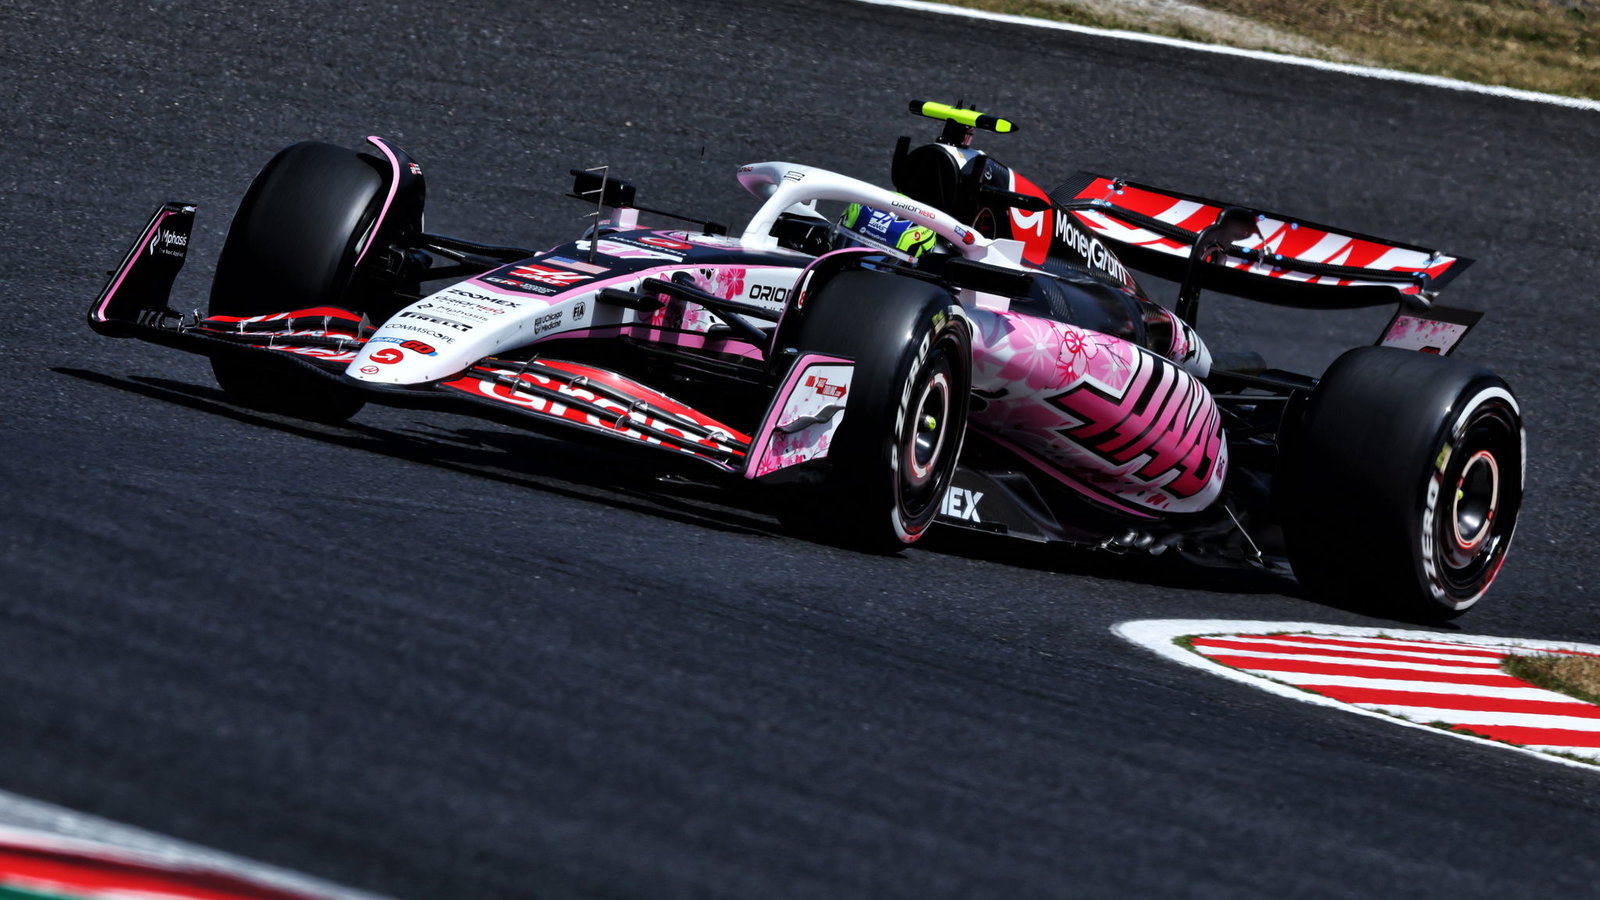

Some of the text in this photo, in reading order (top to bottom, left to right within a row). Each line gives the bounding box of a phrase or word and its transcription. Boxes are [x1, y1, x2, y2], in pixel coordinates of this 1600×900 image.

[161, 229, 187, 247] Mphasis
[1055, 209, 1128, 286] MoneyGram
[447, 288, 521, 308] ZOOMEX
[385, 323, 456, 345] COMMSCOPE
[1421, 474, 1441, 582] ZERO
